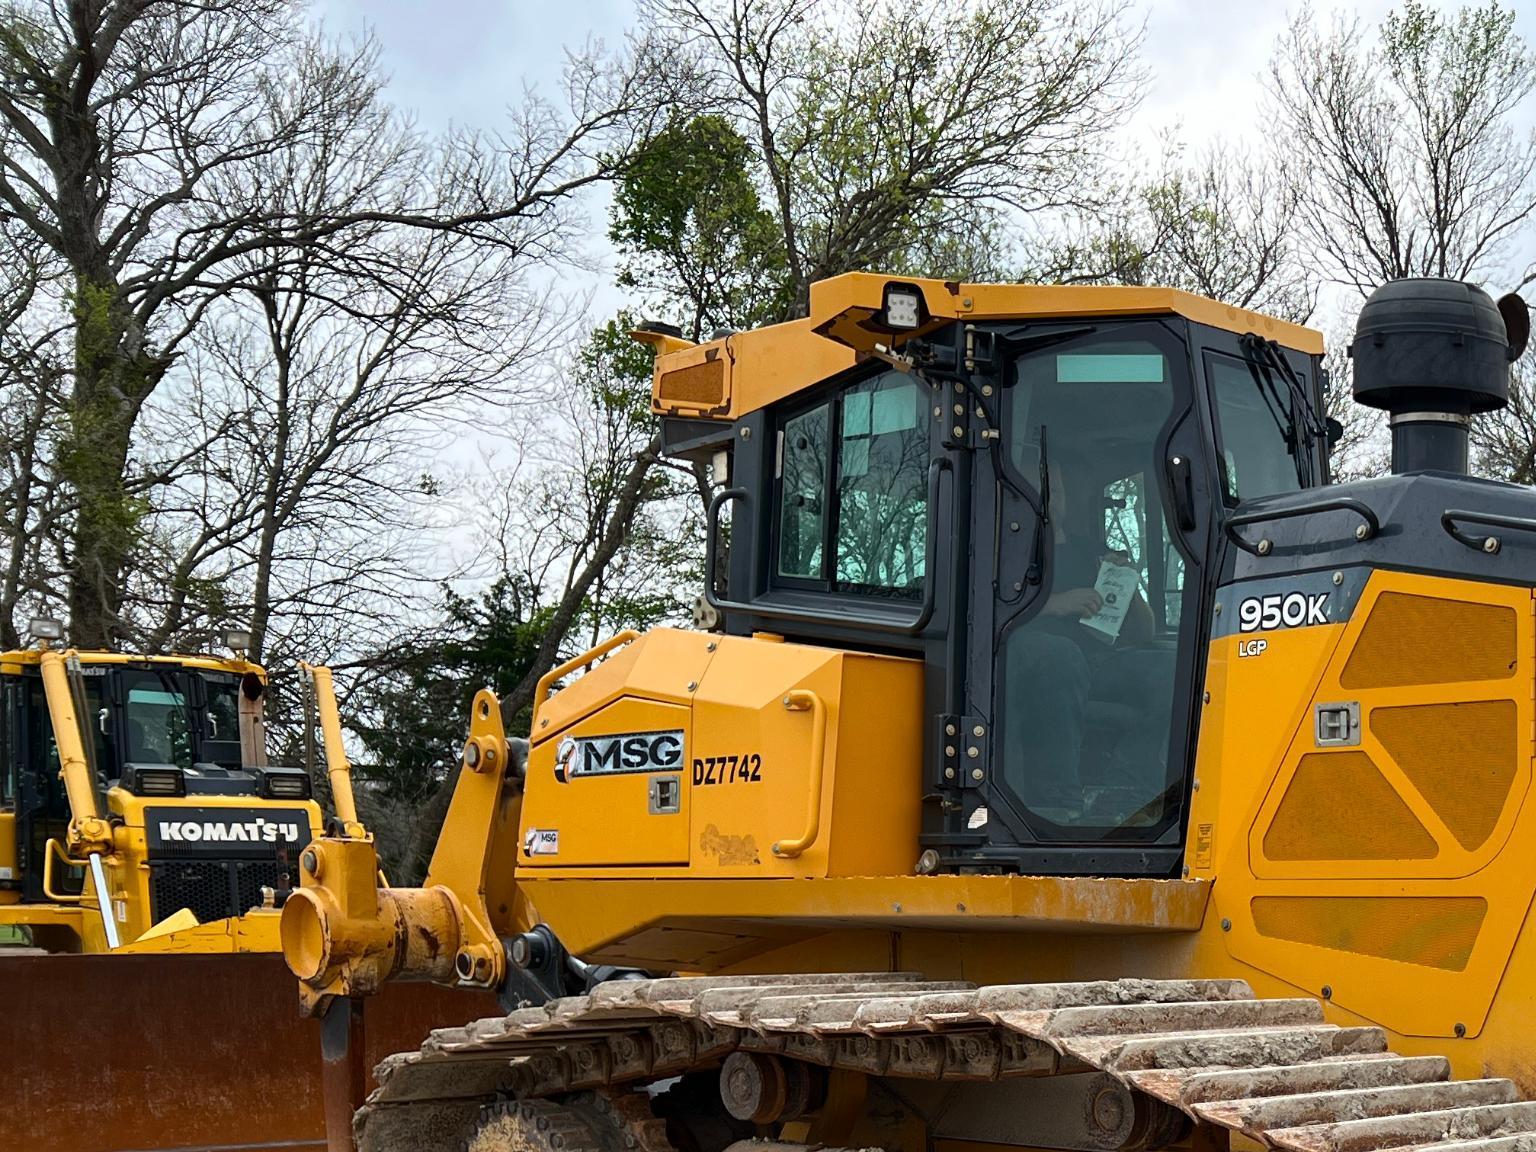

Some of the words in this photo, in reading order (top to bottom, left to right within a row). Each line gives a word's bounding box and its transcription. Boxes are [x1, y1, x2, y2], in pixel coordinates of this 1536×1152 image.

[1239, 591, 1330, 633] 950K
[1238, 639, 1268, 657] LGP
[584, 736, 681, 771] MSG
[693, 753, 762, 786] DZ7742
[159, 818, 299, 842] KOMATSU
[541, 833, 557, 843] MSG
